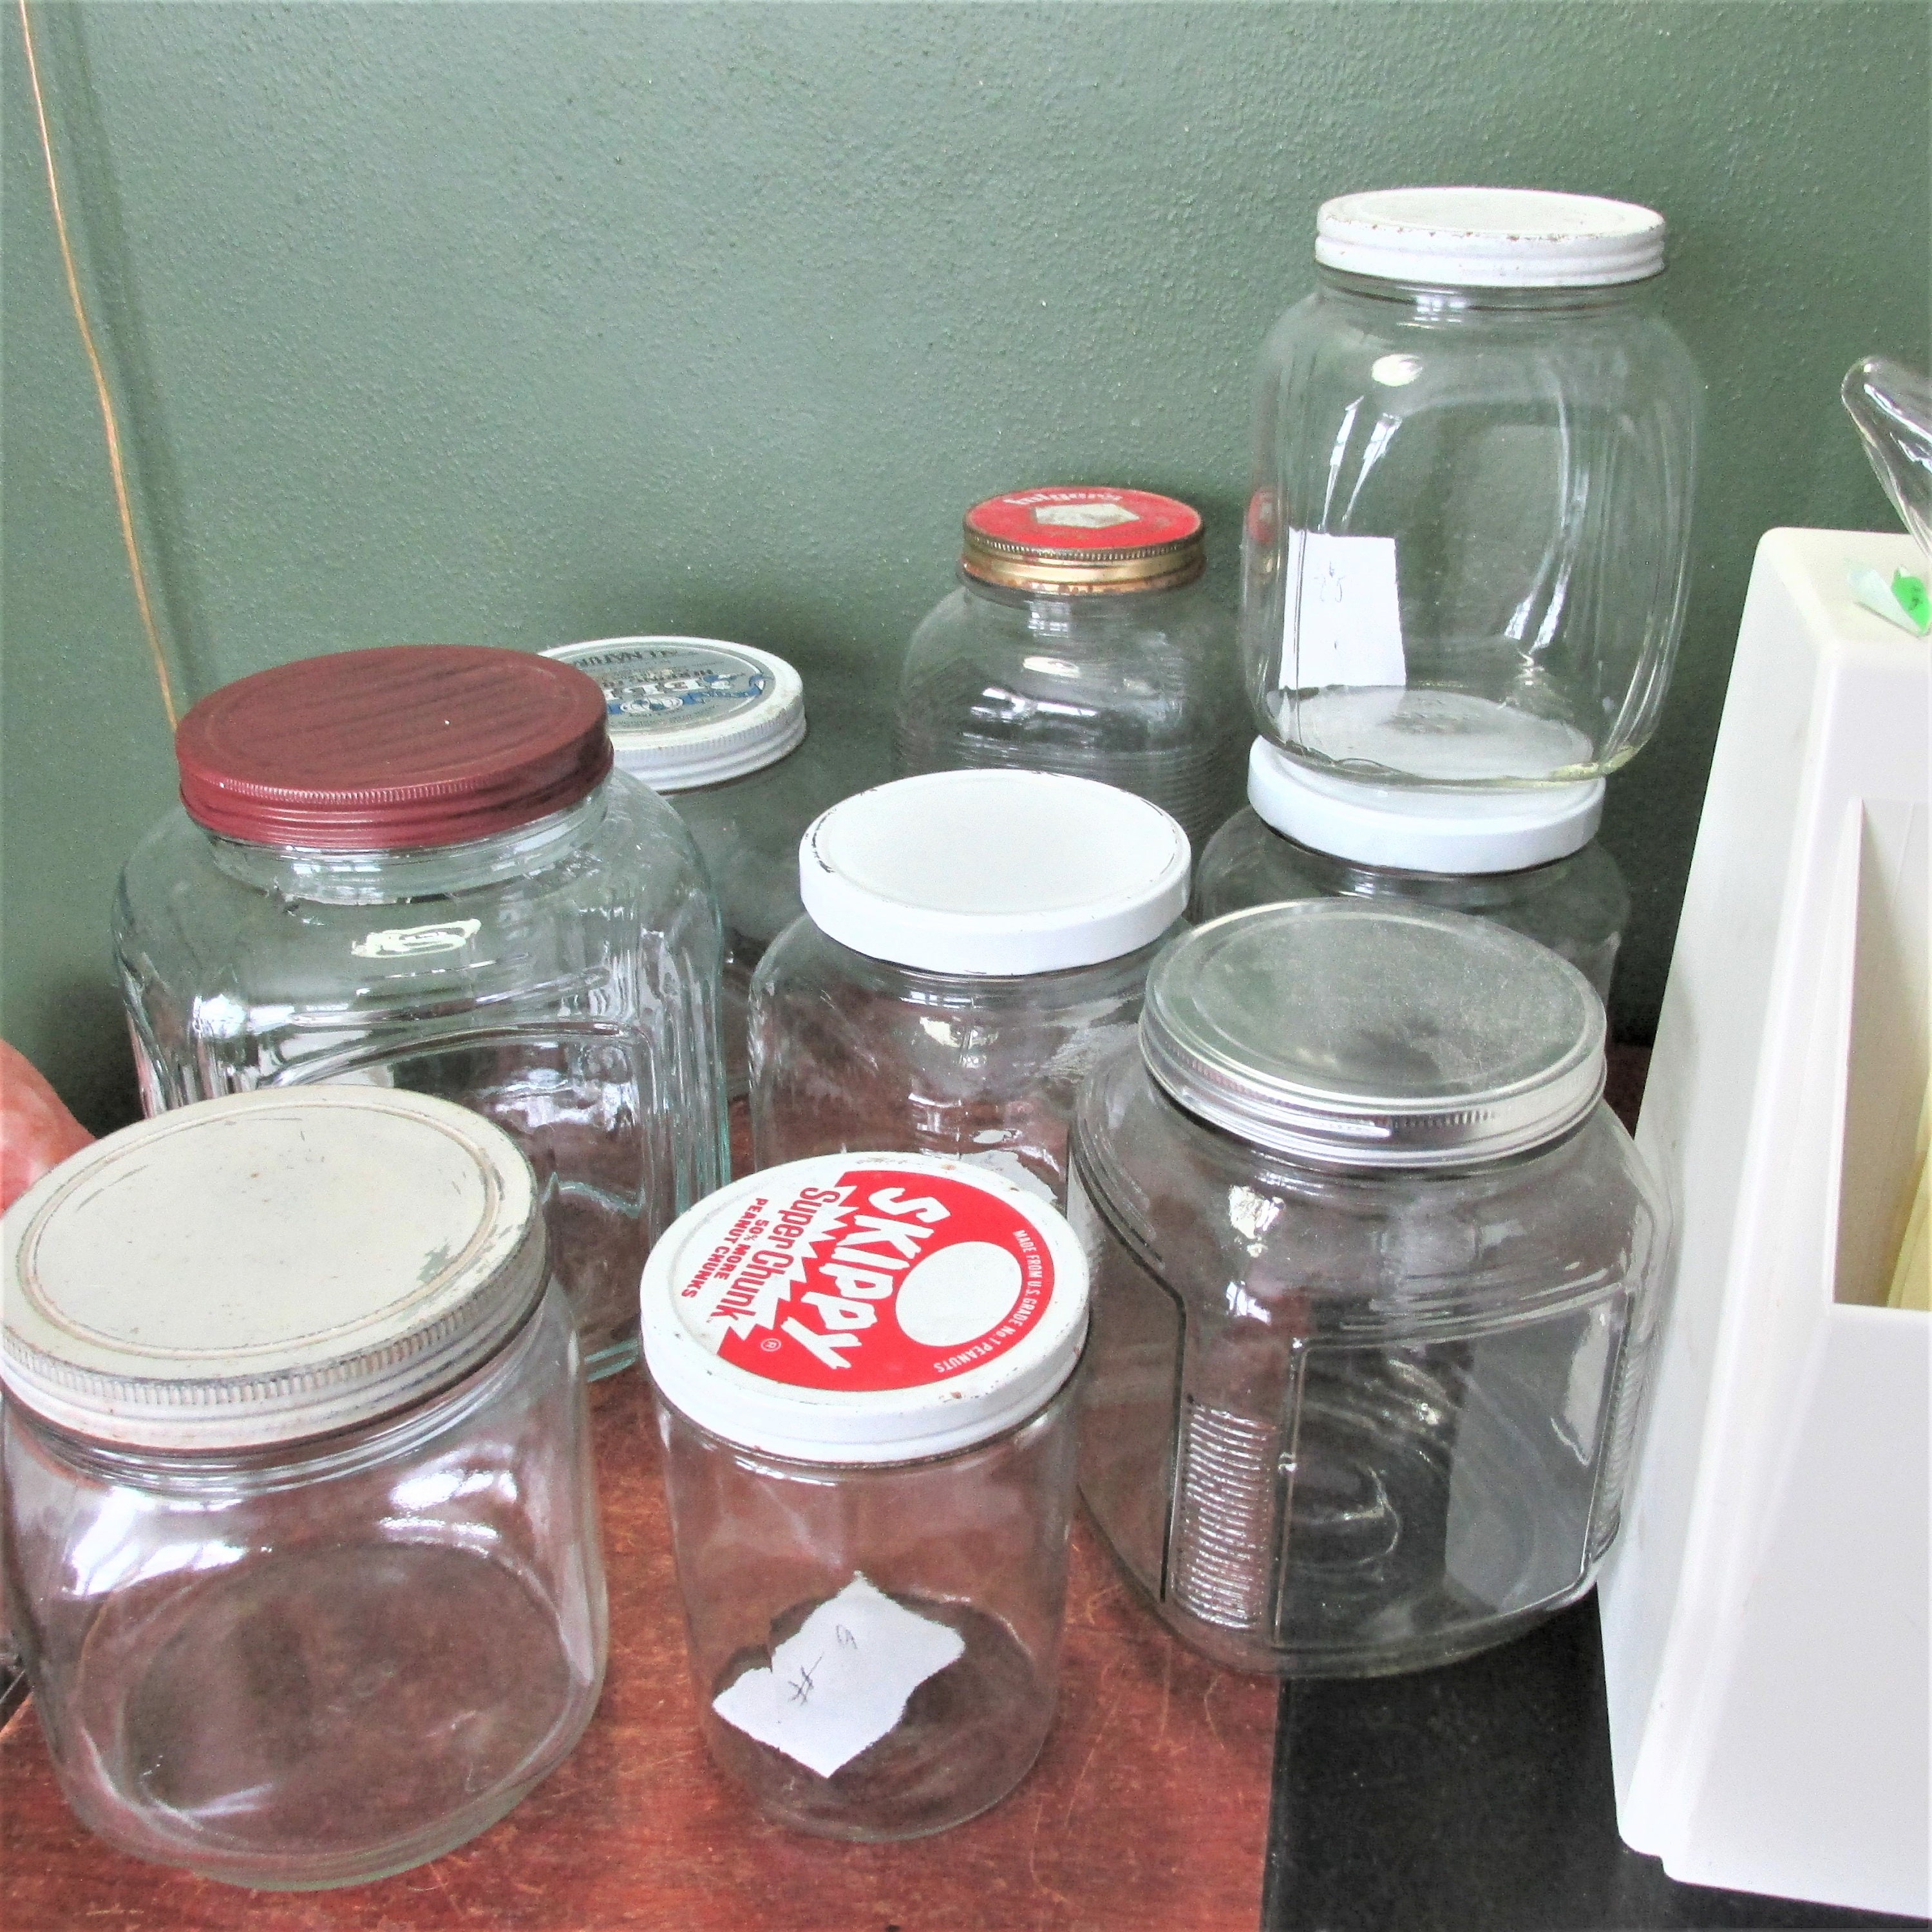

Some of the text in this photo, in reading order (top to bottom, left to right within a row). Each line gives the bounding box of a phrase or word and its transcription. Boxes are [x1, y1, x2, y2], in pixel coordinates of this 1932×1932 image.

[681, 1198, 769, 1298] PEANUT CHUNKS
[710, 1187, 840, 1321] Super Chunk
[714, 1219, 770, 1280] 50% MORE
[1012, 1229, 1036, 1253] MADE
[781, 1187, 951, 1369] SKIPPY
[1026, 1255, 1043, 1278] FROM
[1026, 1281, 1042, 1296] U.S.
[1009, 1298, 1037, 1327] GRADE
[933, 1342, 993, 1373] PEANUTS
